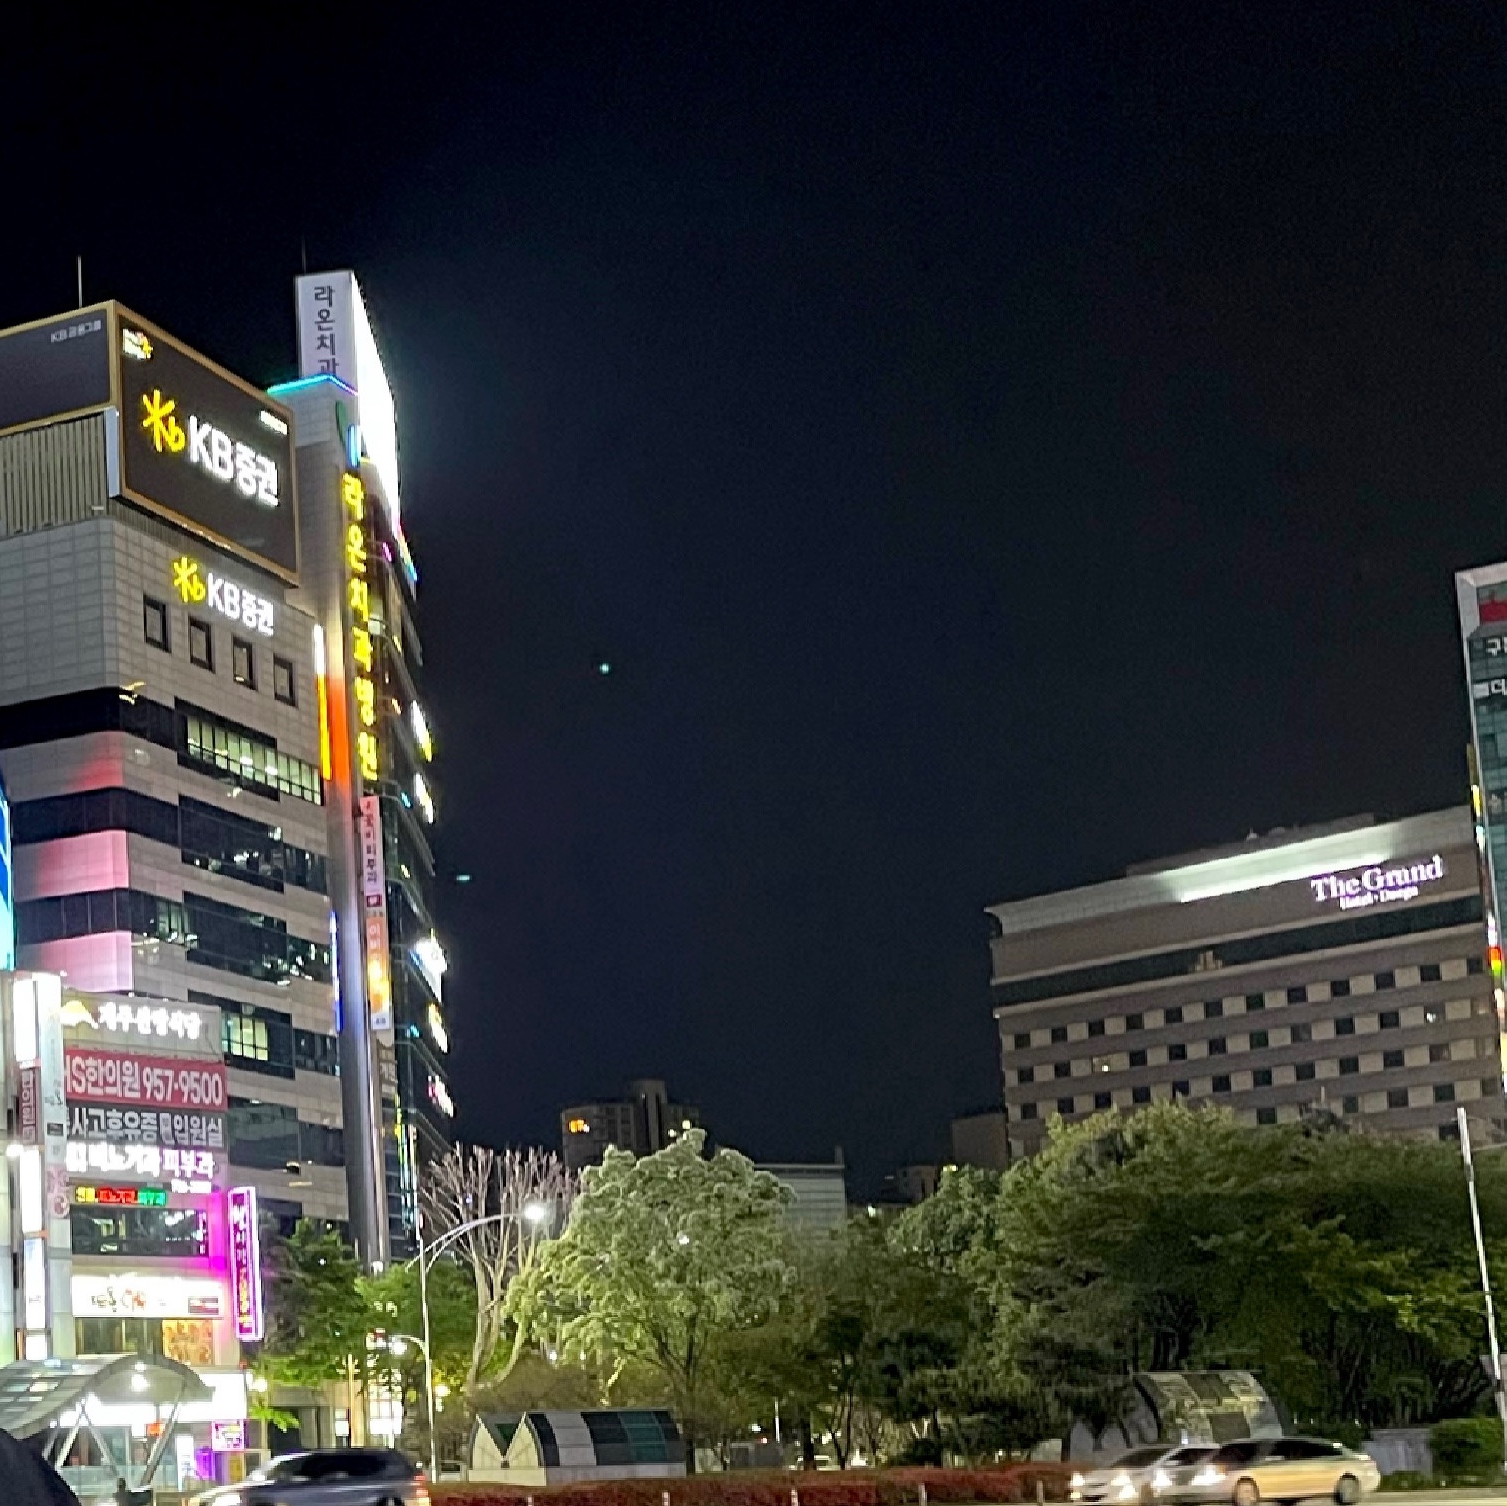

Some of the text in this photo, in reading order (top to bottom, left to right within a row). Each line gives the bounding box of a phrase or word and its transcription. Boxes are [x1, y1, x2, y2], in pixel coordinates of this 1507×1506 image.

[314, 285, 339, 375] 라온치과
[342, 472, 379, 782] 라온치과병원
[1310, 854, 1444, 902] The Grand
[142, 1066, 223, 1106] 957-9500
[66, 1106, 157, 1143] 사고후유증
[174, 1113, 223, 1148] 입원실
[162, 1148, 215, 1179] 피부과
